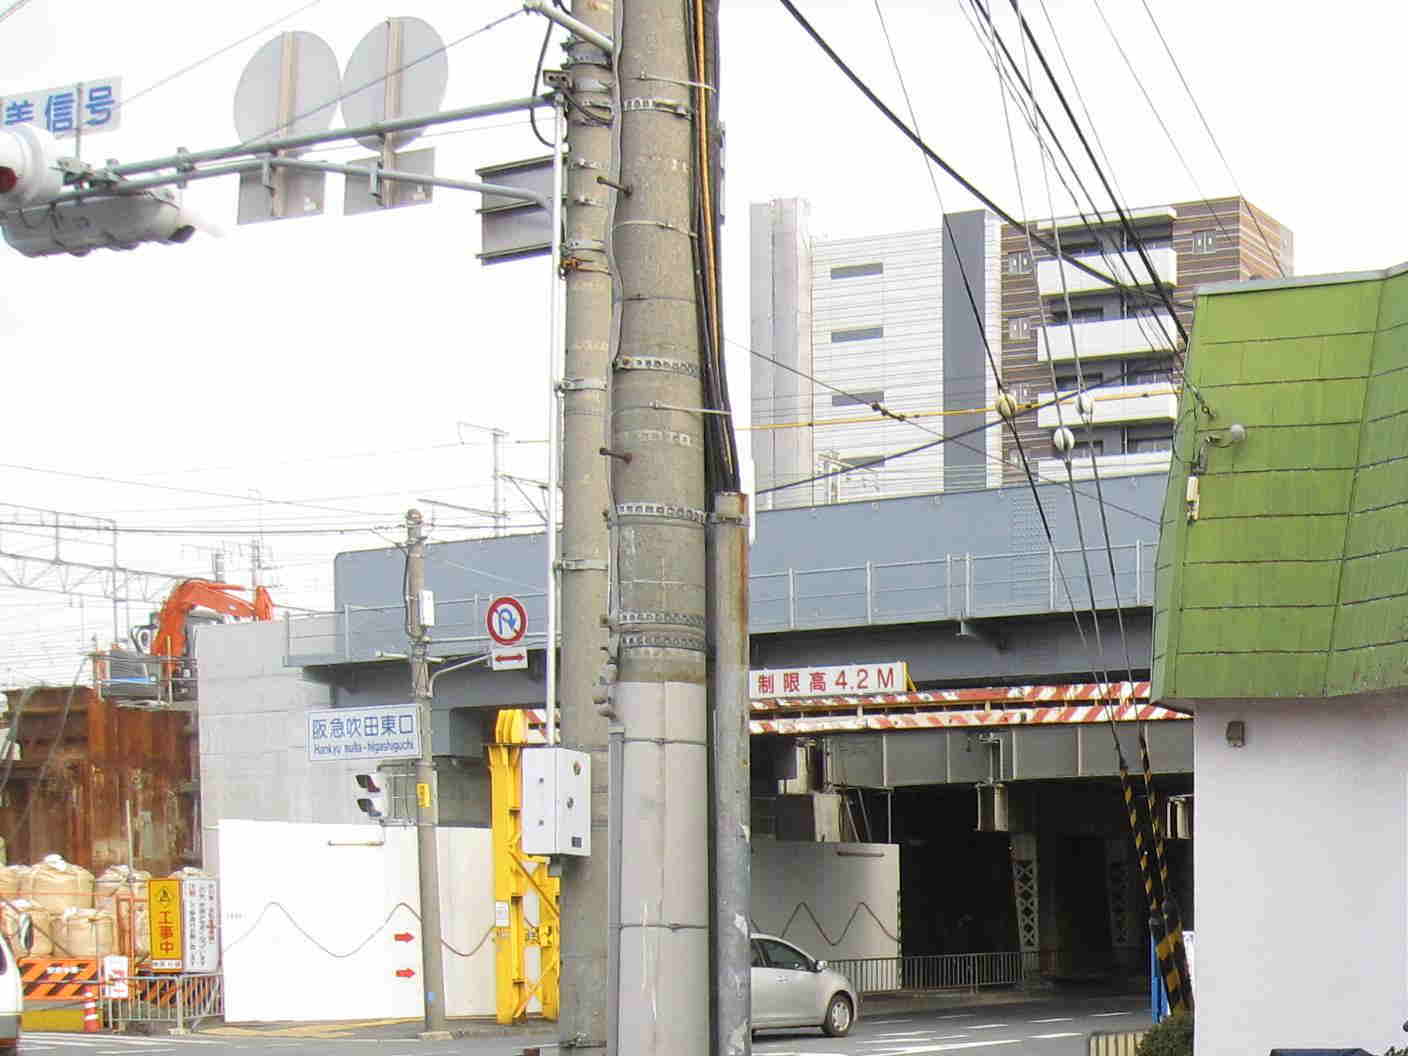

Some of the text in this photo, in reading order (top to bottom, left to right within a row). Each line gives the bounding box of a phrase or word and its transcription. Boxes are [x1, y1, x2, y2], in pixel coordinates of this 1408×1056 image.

[312, 714, 414, 739] 阪急吹田東口
[158, 911, 174, 956] 工事中
